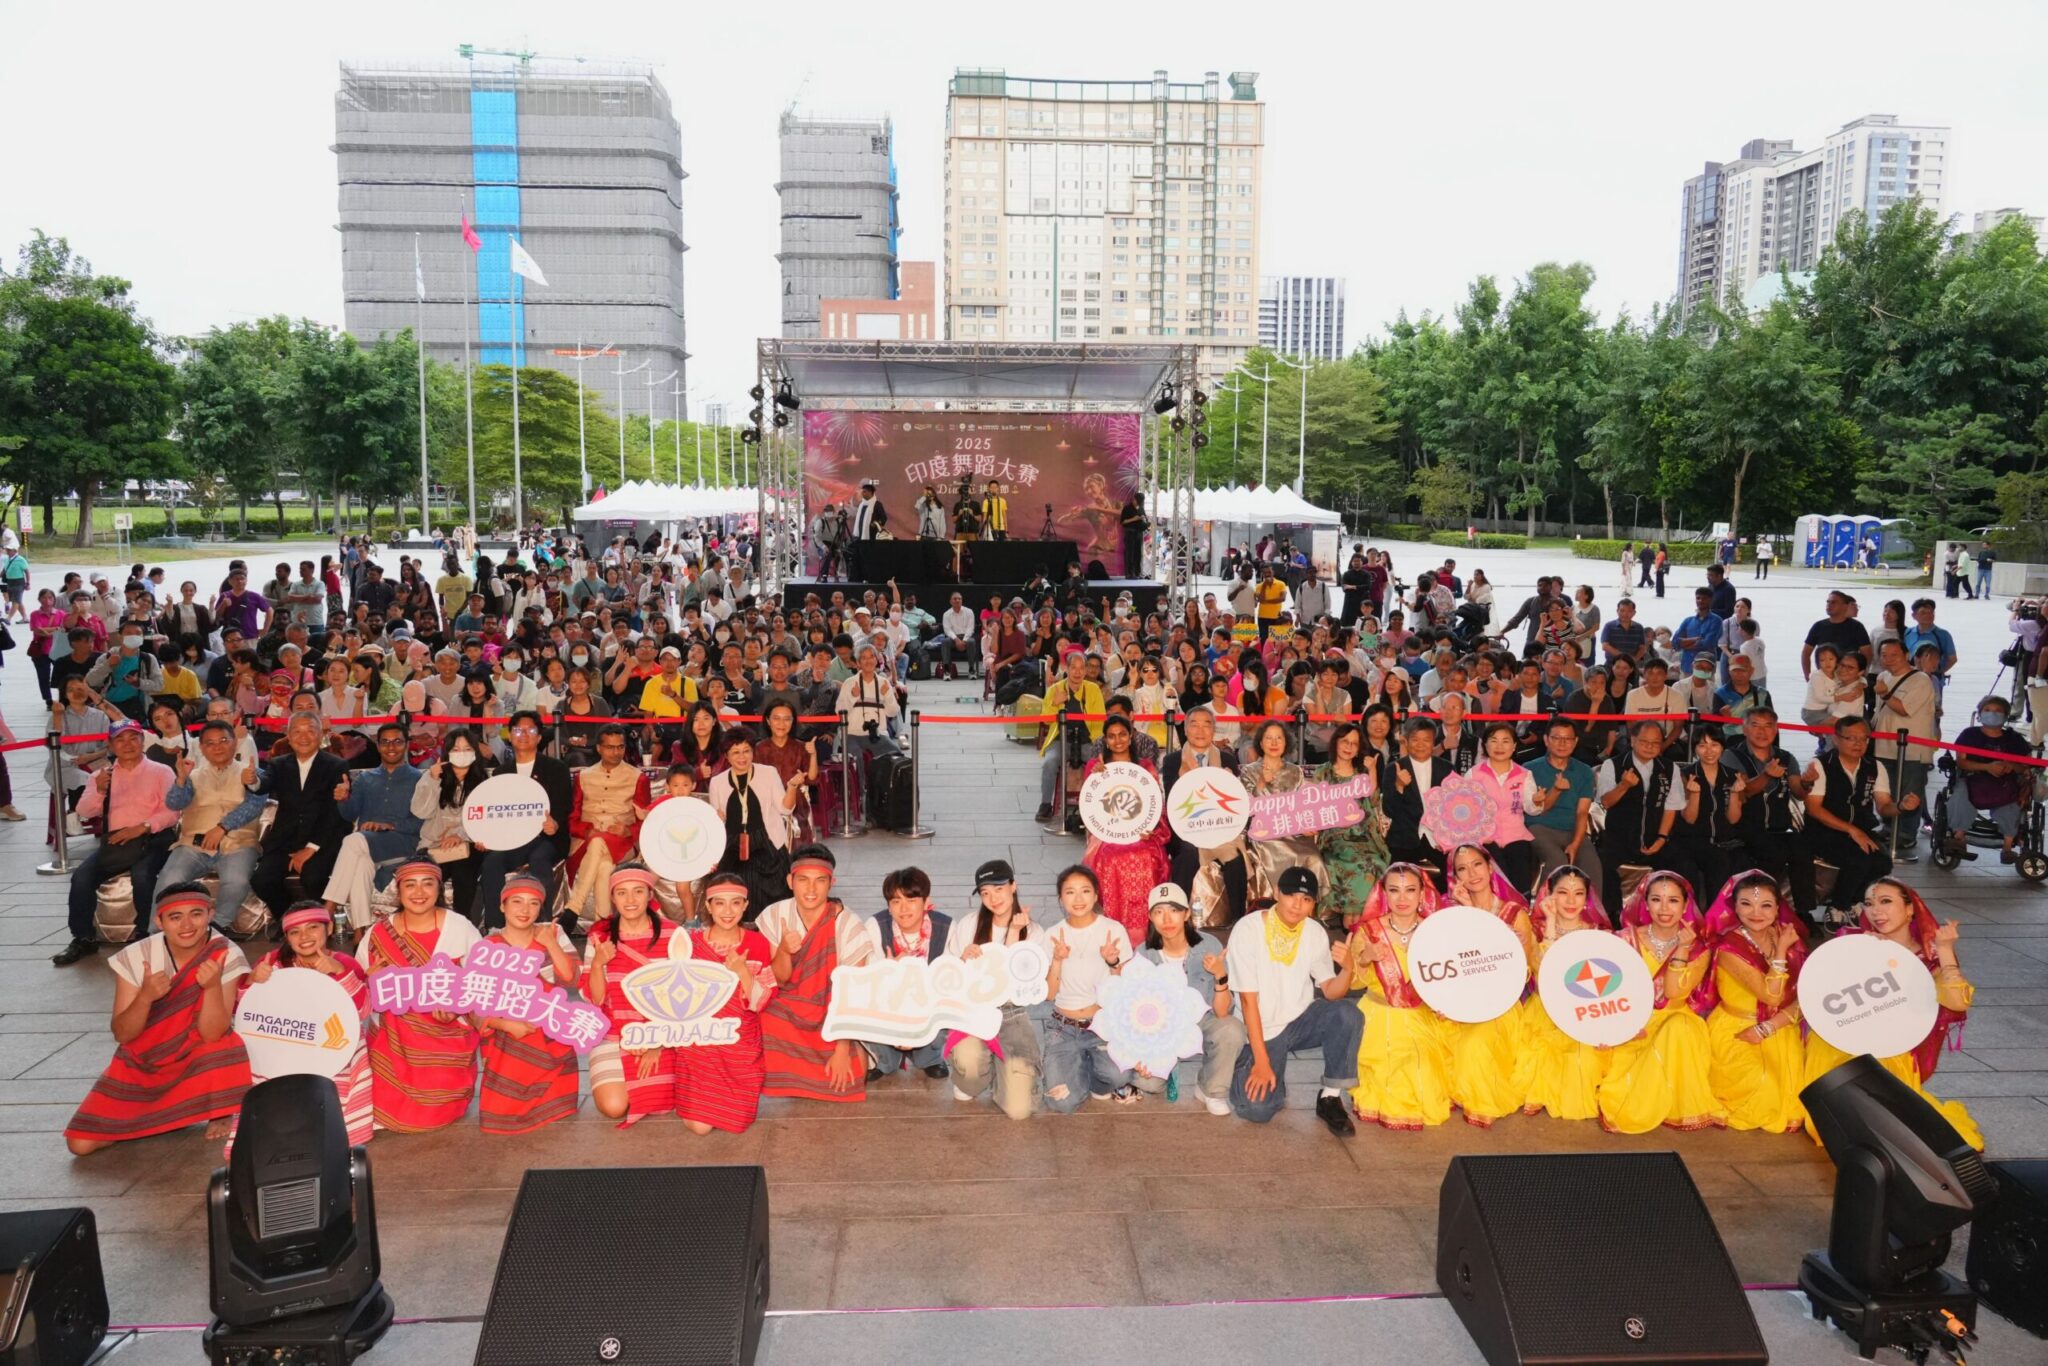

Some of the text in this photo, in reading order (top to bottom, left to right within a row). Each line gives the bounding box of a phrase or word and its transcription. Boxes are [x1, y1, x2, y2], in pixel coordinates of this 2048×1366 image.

[955, 437, 992, 450] 2025
[904, 452, 1040, 488] 印度舞蹈大賽
[1249, 777, 1371, 816] appy Diwali
[1089, 795, 1157, 839] INDIA TAIPEI ASSOCIATION
[1272, 805, 1340, 836] 排燈節
[472, 945, 540, 975] 2025
[1457, 949, 1482, 960] TATA
[1460, 952, 1514, 968] CONSULTANCY
[1417, 959, 1458, 983] tcs
[1462, 964, 1498, 977] SERVICES
[376, 967, 605, 1049] 印度舞蹈大賽
[1575, 997, 1632, 1021] PSMC
[1836, 995, 1908, 1028] Discover Reliable
[243, 1011, 317, 1032] SINGAPORE
[256, 1022, 316, 1041] AIRLINES
[623, 1021, 737, 1046] DIWALI
